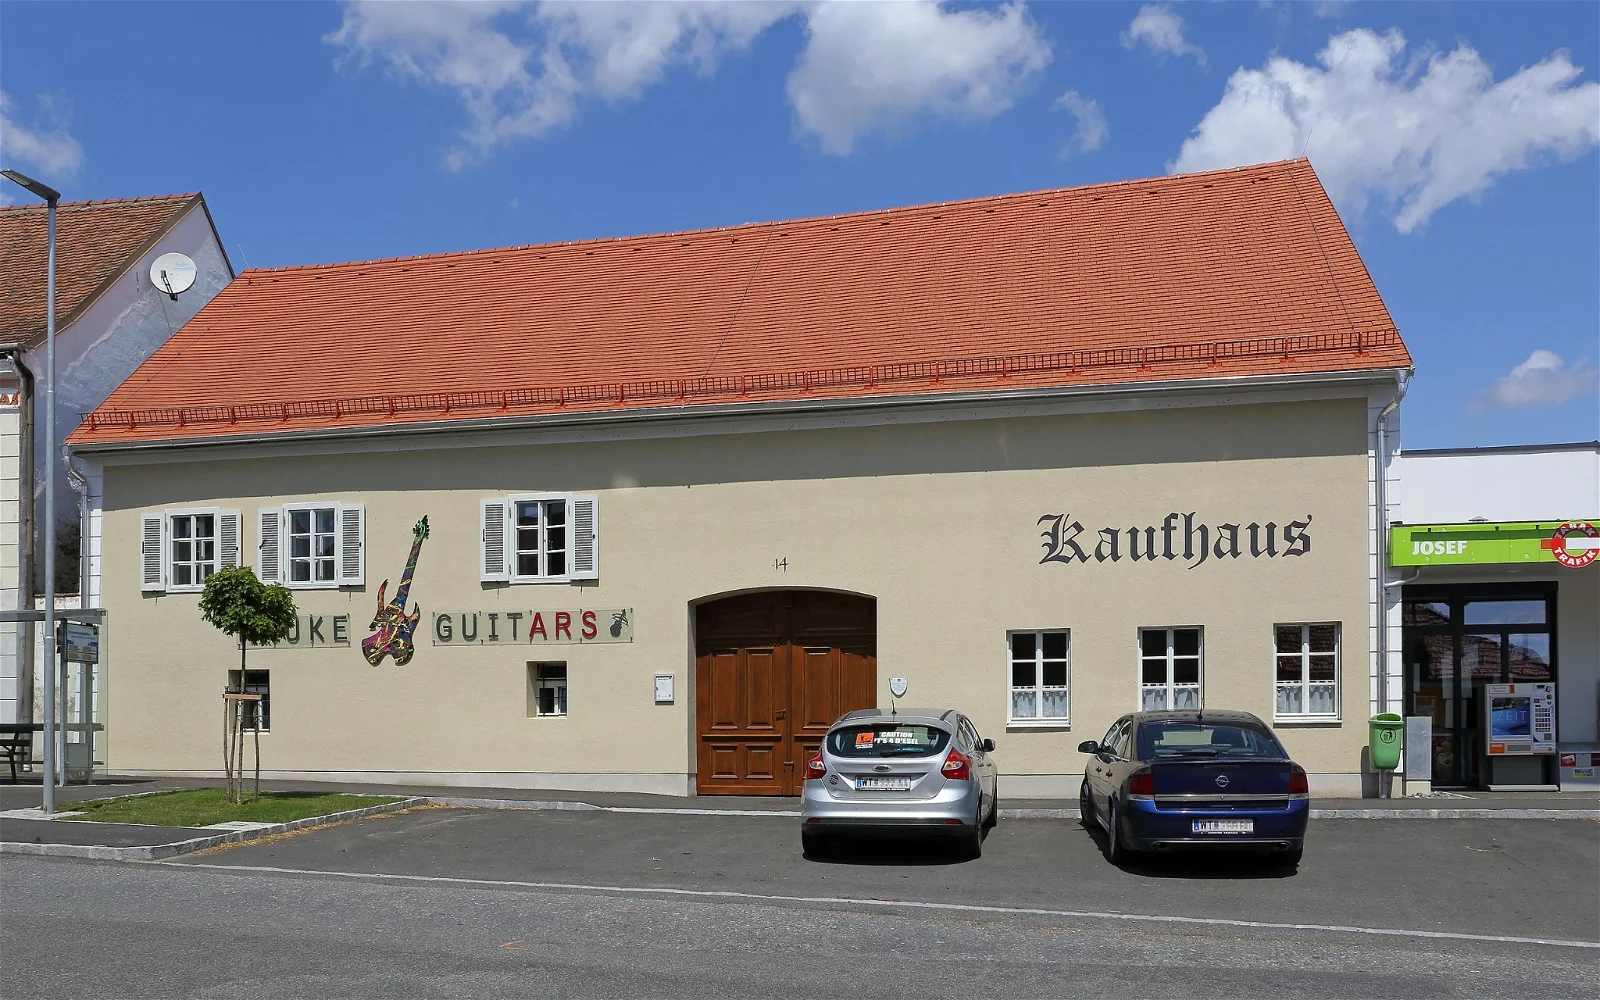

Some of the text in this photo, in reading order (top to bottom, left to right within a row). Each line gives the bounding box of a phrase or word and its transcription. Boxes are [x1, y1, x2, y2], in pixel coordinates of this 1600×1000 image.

[1554, 523, 1596, 539] TABAK
[1037, 511, 1312, 570] Kaufhaus
[1412, 541, 1467, 555] JOSEF
[1554, 547, 1596, 565] TRAFIK
[286, 610, 598, 644] UKE GUITARS
[1495, 710, 1527, 721] ZEIT
